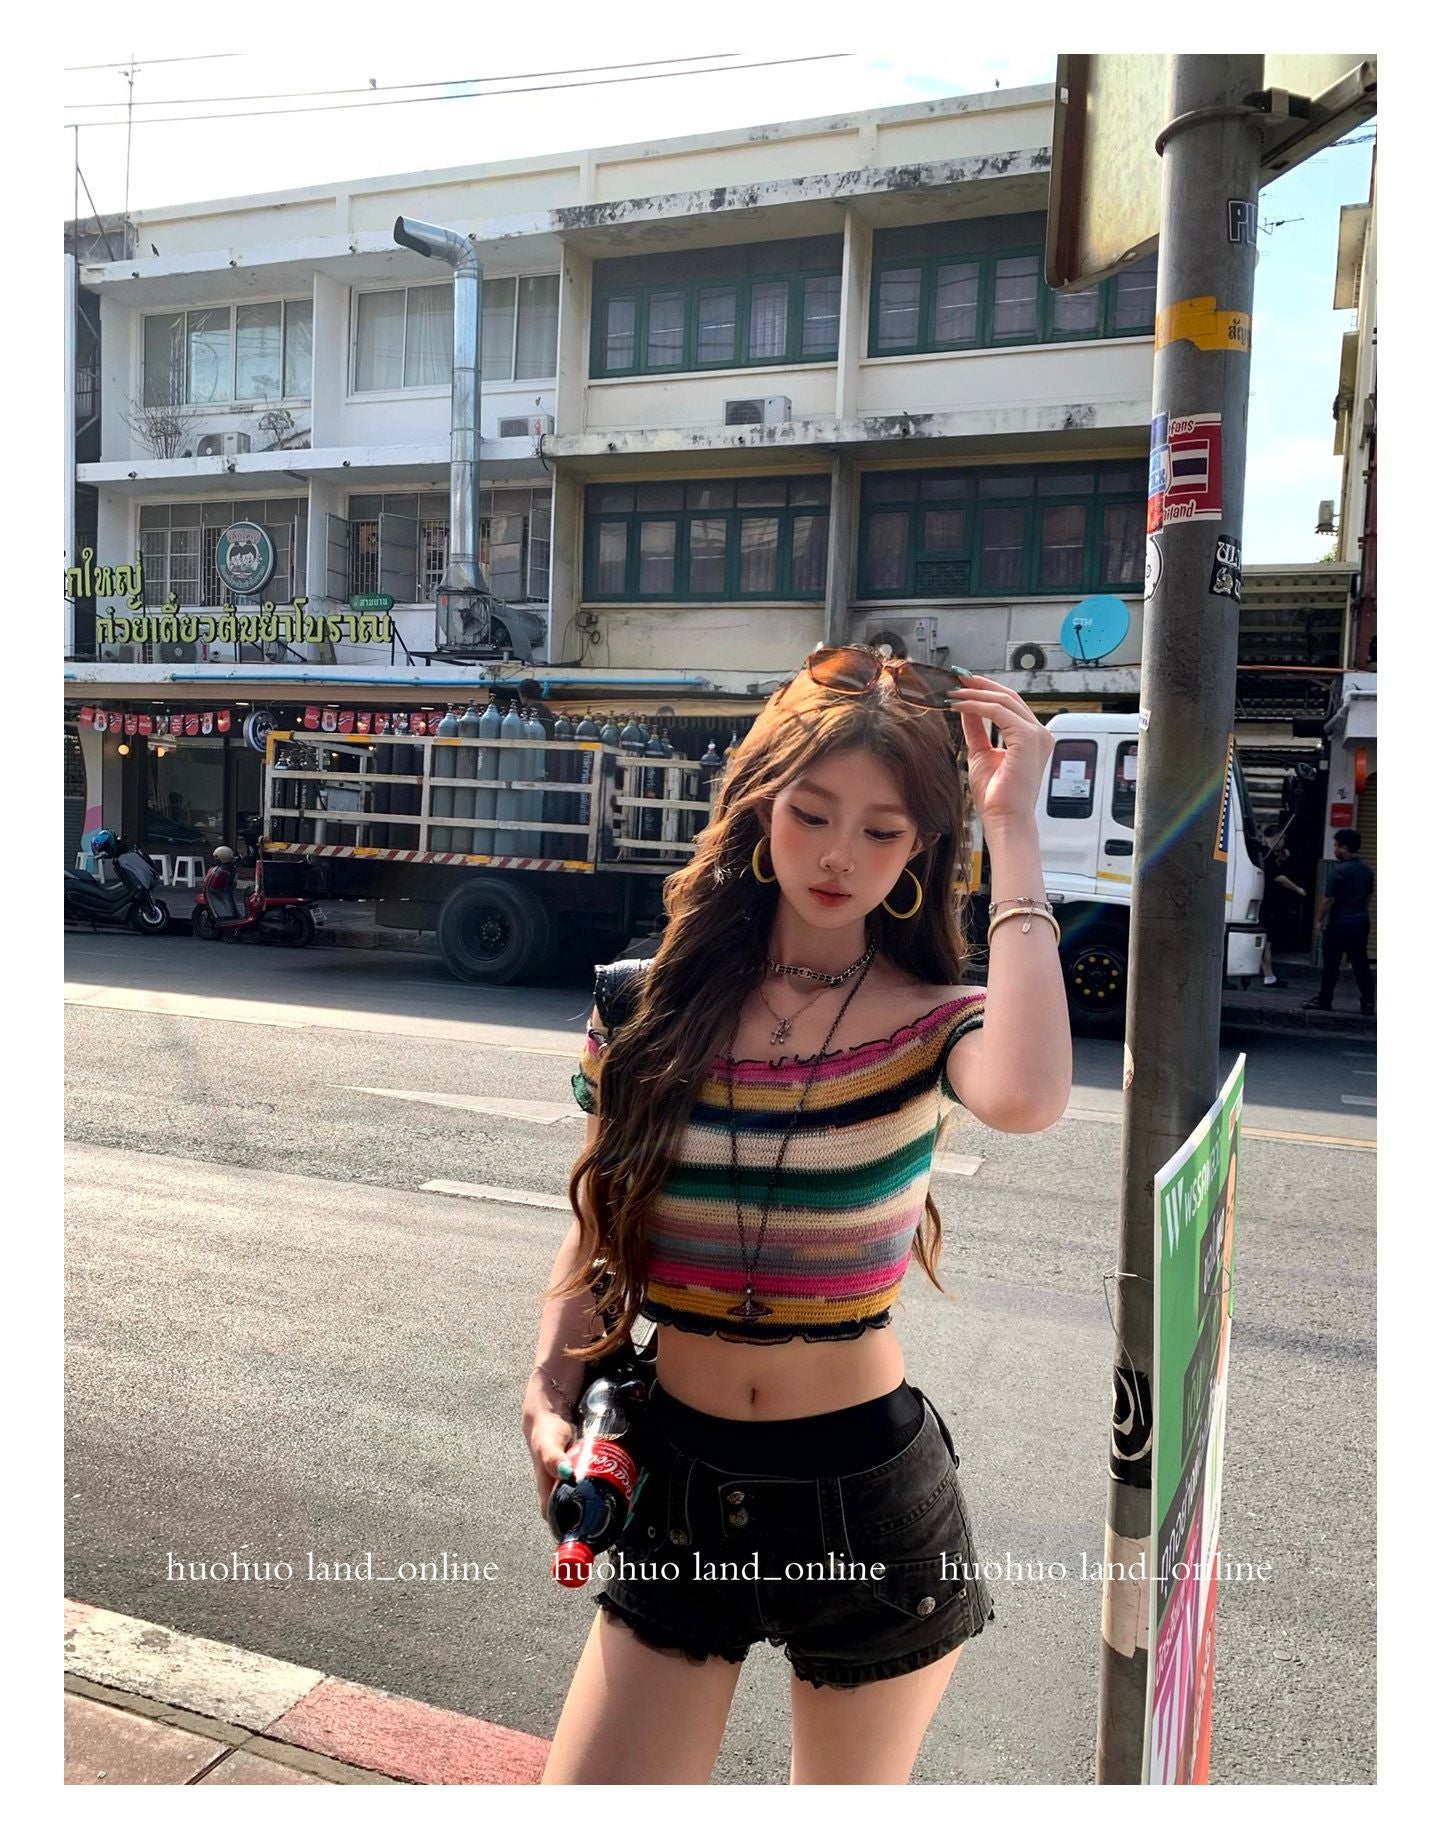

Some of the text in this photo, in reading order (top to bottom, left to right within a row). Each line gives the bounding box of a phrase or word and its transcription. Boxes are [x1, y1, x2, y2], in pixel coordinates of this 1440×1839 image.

[1168, 420, 1195, 434] fans
[65, 547, 143, 610] กใหญ่
[96, 592, 393, 643] ก๋วยเตี๋ยวต้มยำโบราณ
